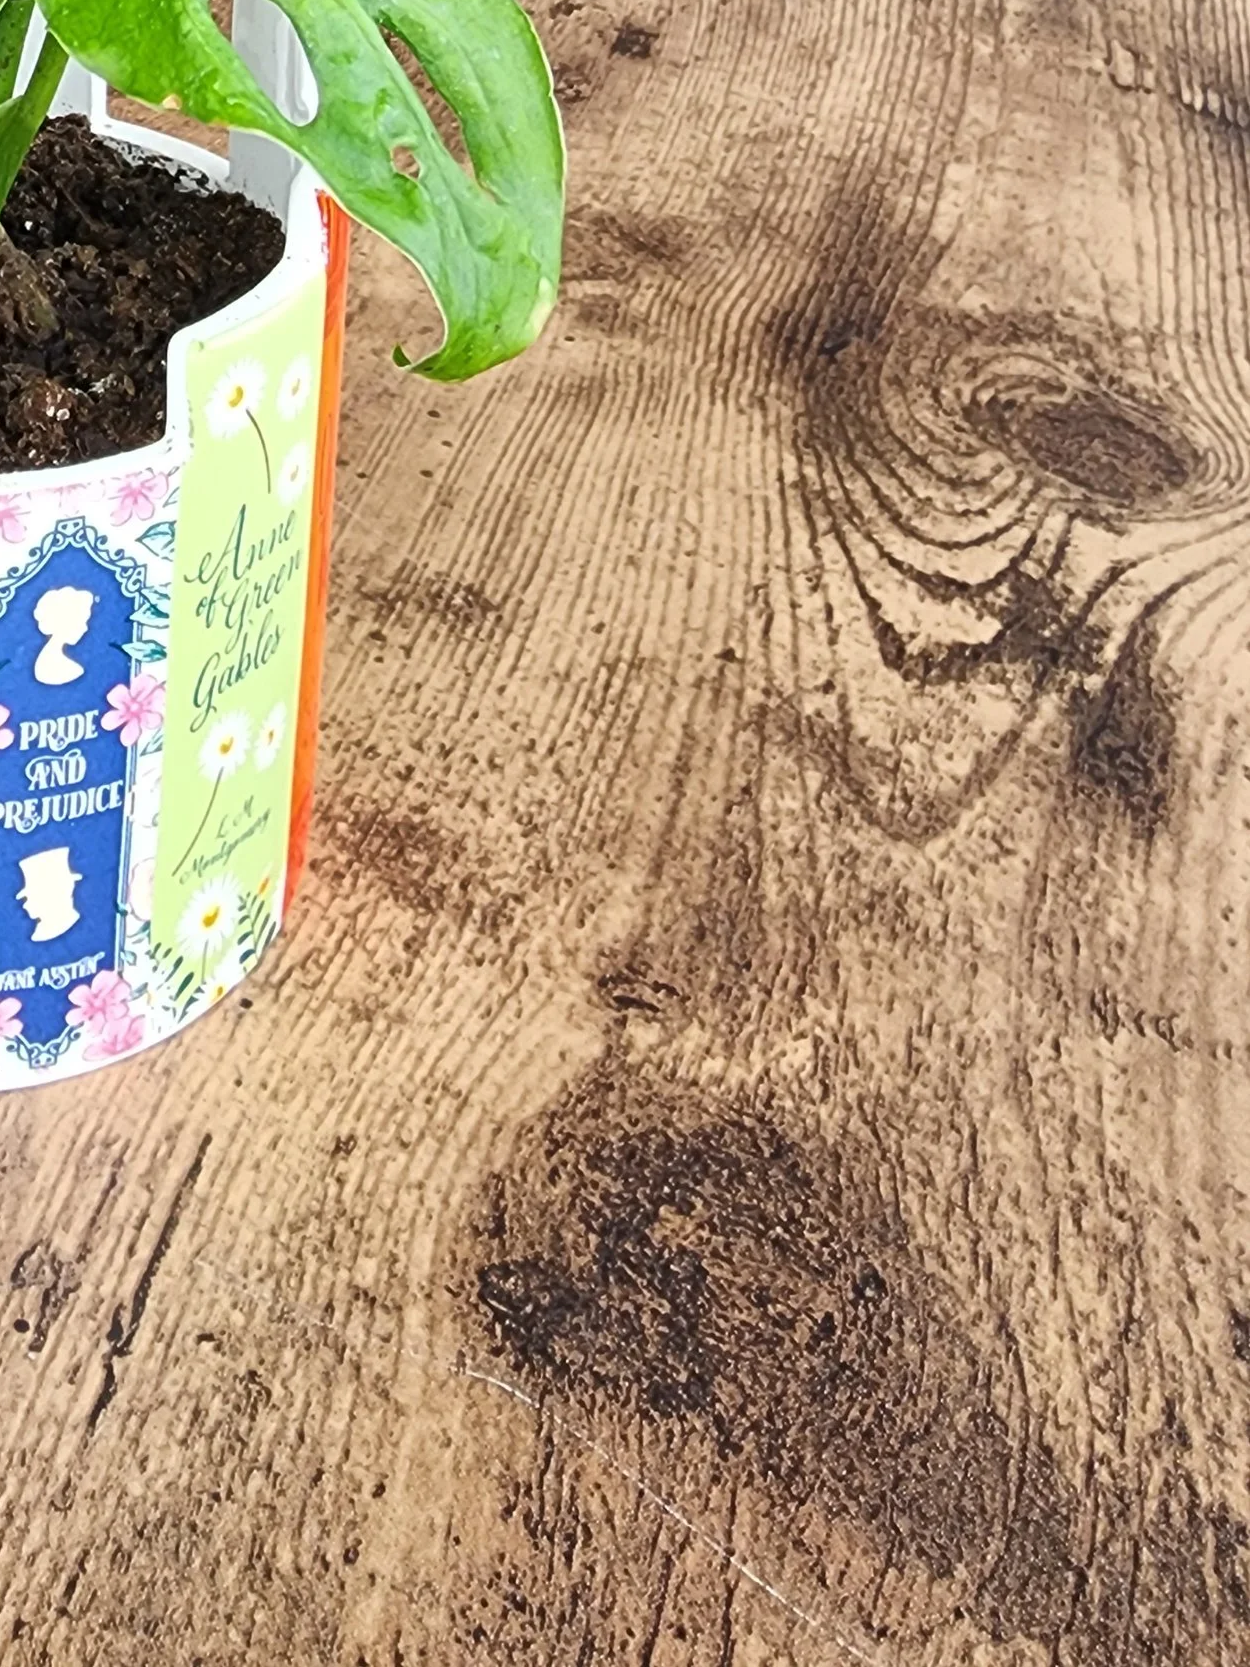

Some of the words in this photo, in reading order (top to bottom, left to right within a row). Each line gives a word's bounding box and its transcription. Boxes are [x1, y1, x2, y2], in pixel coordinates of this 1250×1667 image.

[183, 503, 296, 585] Anne
[195, 565, 228, 629] of
[221, 549, 302, 655] Green
[189, 608, 284, 733] Gables
[19, 709, 100, 752] PRIDE
[25, 748, 87, 791] AND
[38, 951, 106, 990] AUSTEN
